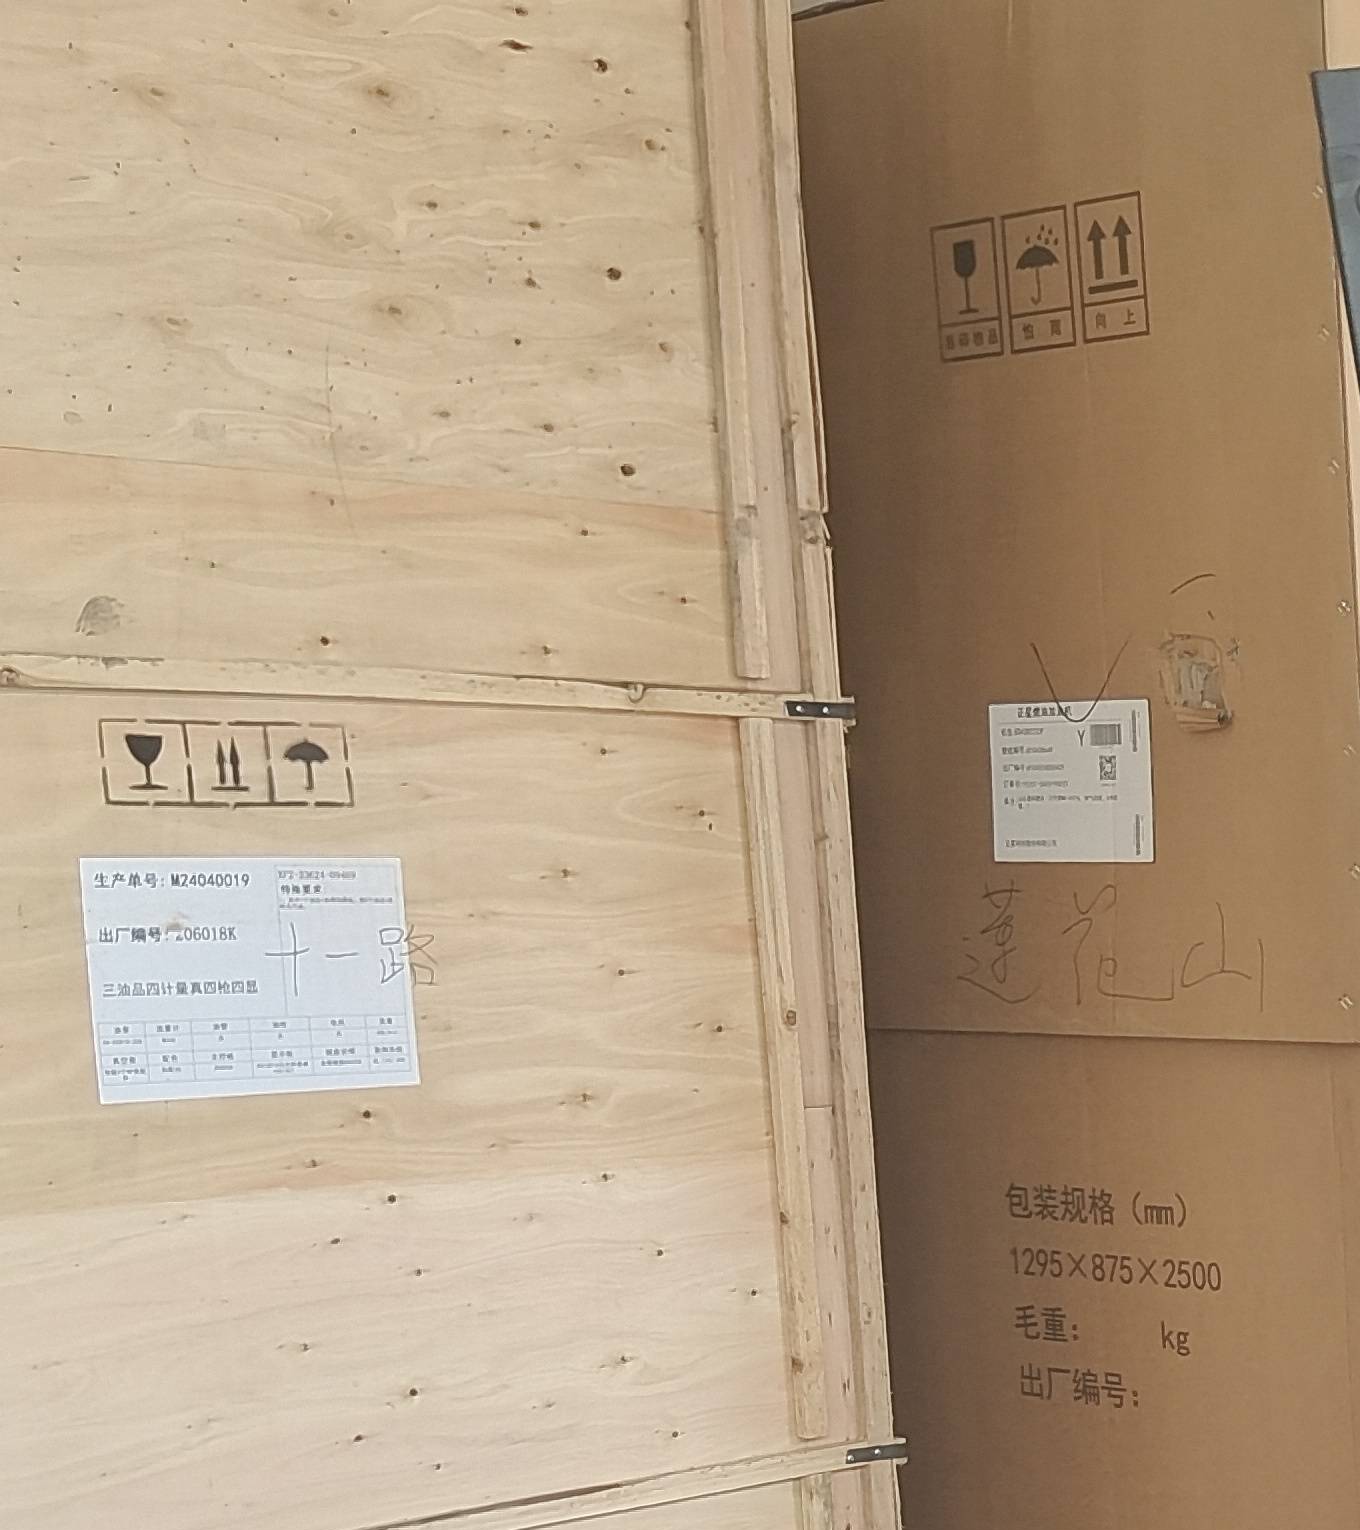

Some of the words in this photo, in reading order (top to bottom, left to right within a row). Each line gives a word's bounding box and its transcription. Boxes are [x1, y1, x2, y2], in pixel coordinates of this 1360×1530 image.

[1095, 308, 1137, 330] 向上
[1160, 1320, 1191, 1357] kg
[1018, 1362, 1140, 1410] 出厂编号：
